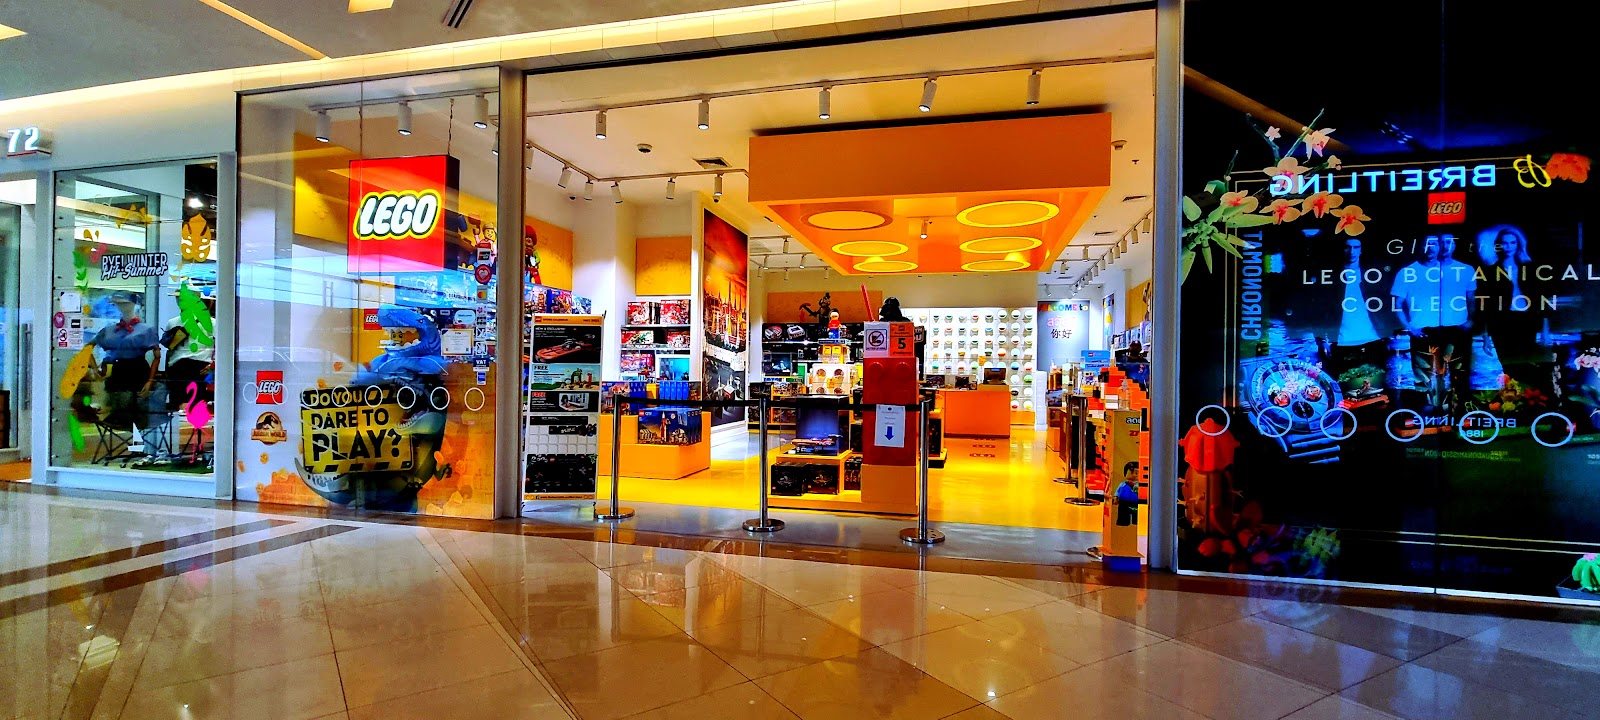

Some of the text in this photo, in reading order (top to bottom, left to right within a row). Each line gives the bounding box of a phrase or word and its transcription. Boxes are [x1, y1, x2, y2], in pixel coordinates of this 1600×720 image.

[6, 126, 41, 153] 72
[357, 192, 440, 237] LEGO
[1429, 201, 1464, 215] LEGO
[1386, 237, 1459, 255] GIFT
[122, 263, 168, 280] Summer
[1403, 264, 1600, 284] BOTANICAL
[1341, 294, 1558, 313] COLLECTION
[1050, 328, 1072, 339] 你好
[897, 337, 907, 350] 5
[258, 381, 281, 394] LEGO
[310, 390, 363, 407] DO YOU
[311, 408, 389, 430] DARE TO
[312, 428, 403, 462] PLAY?
